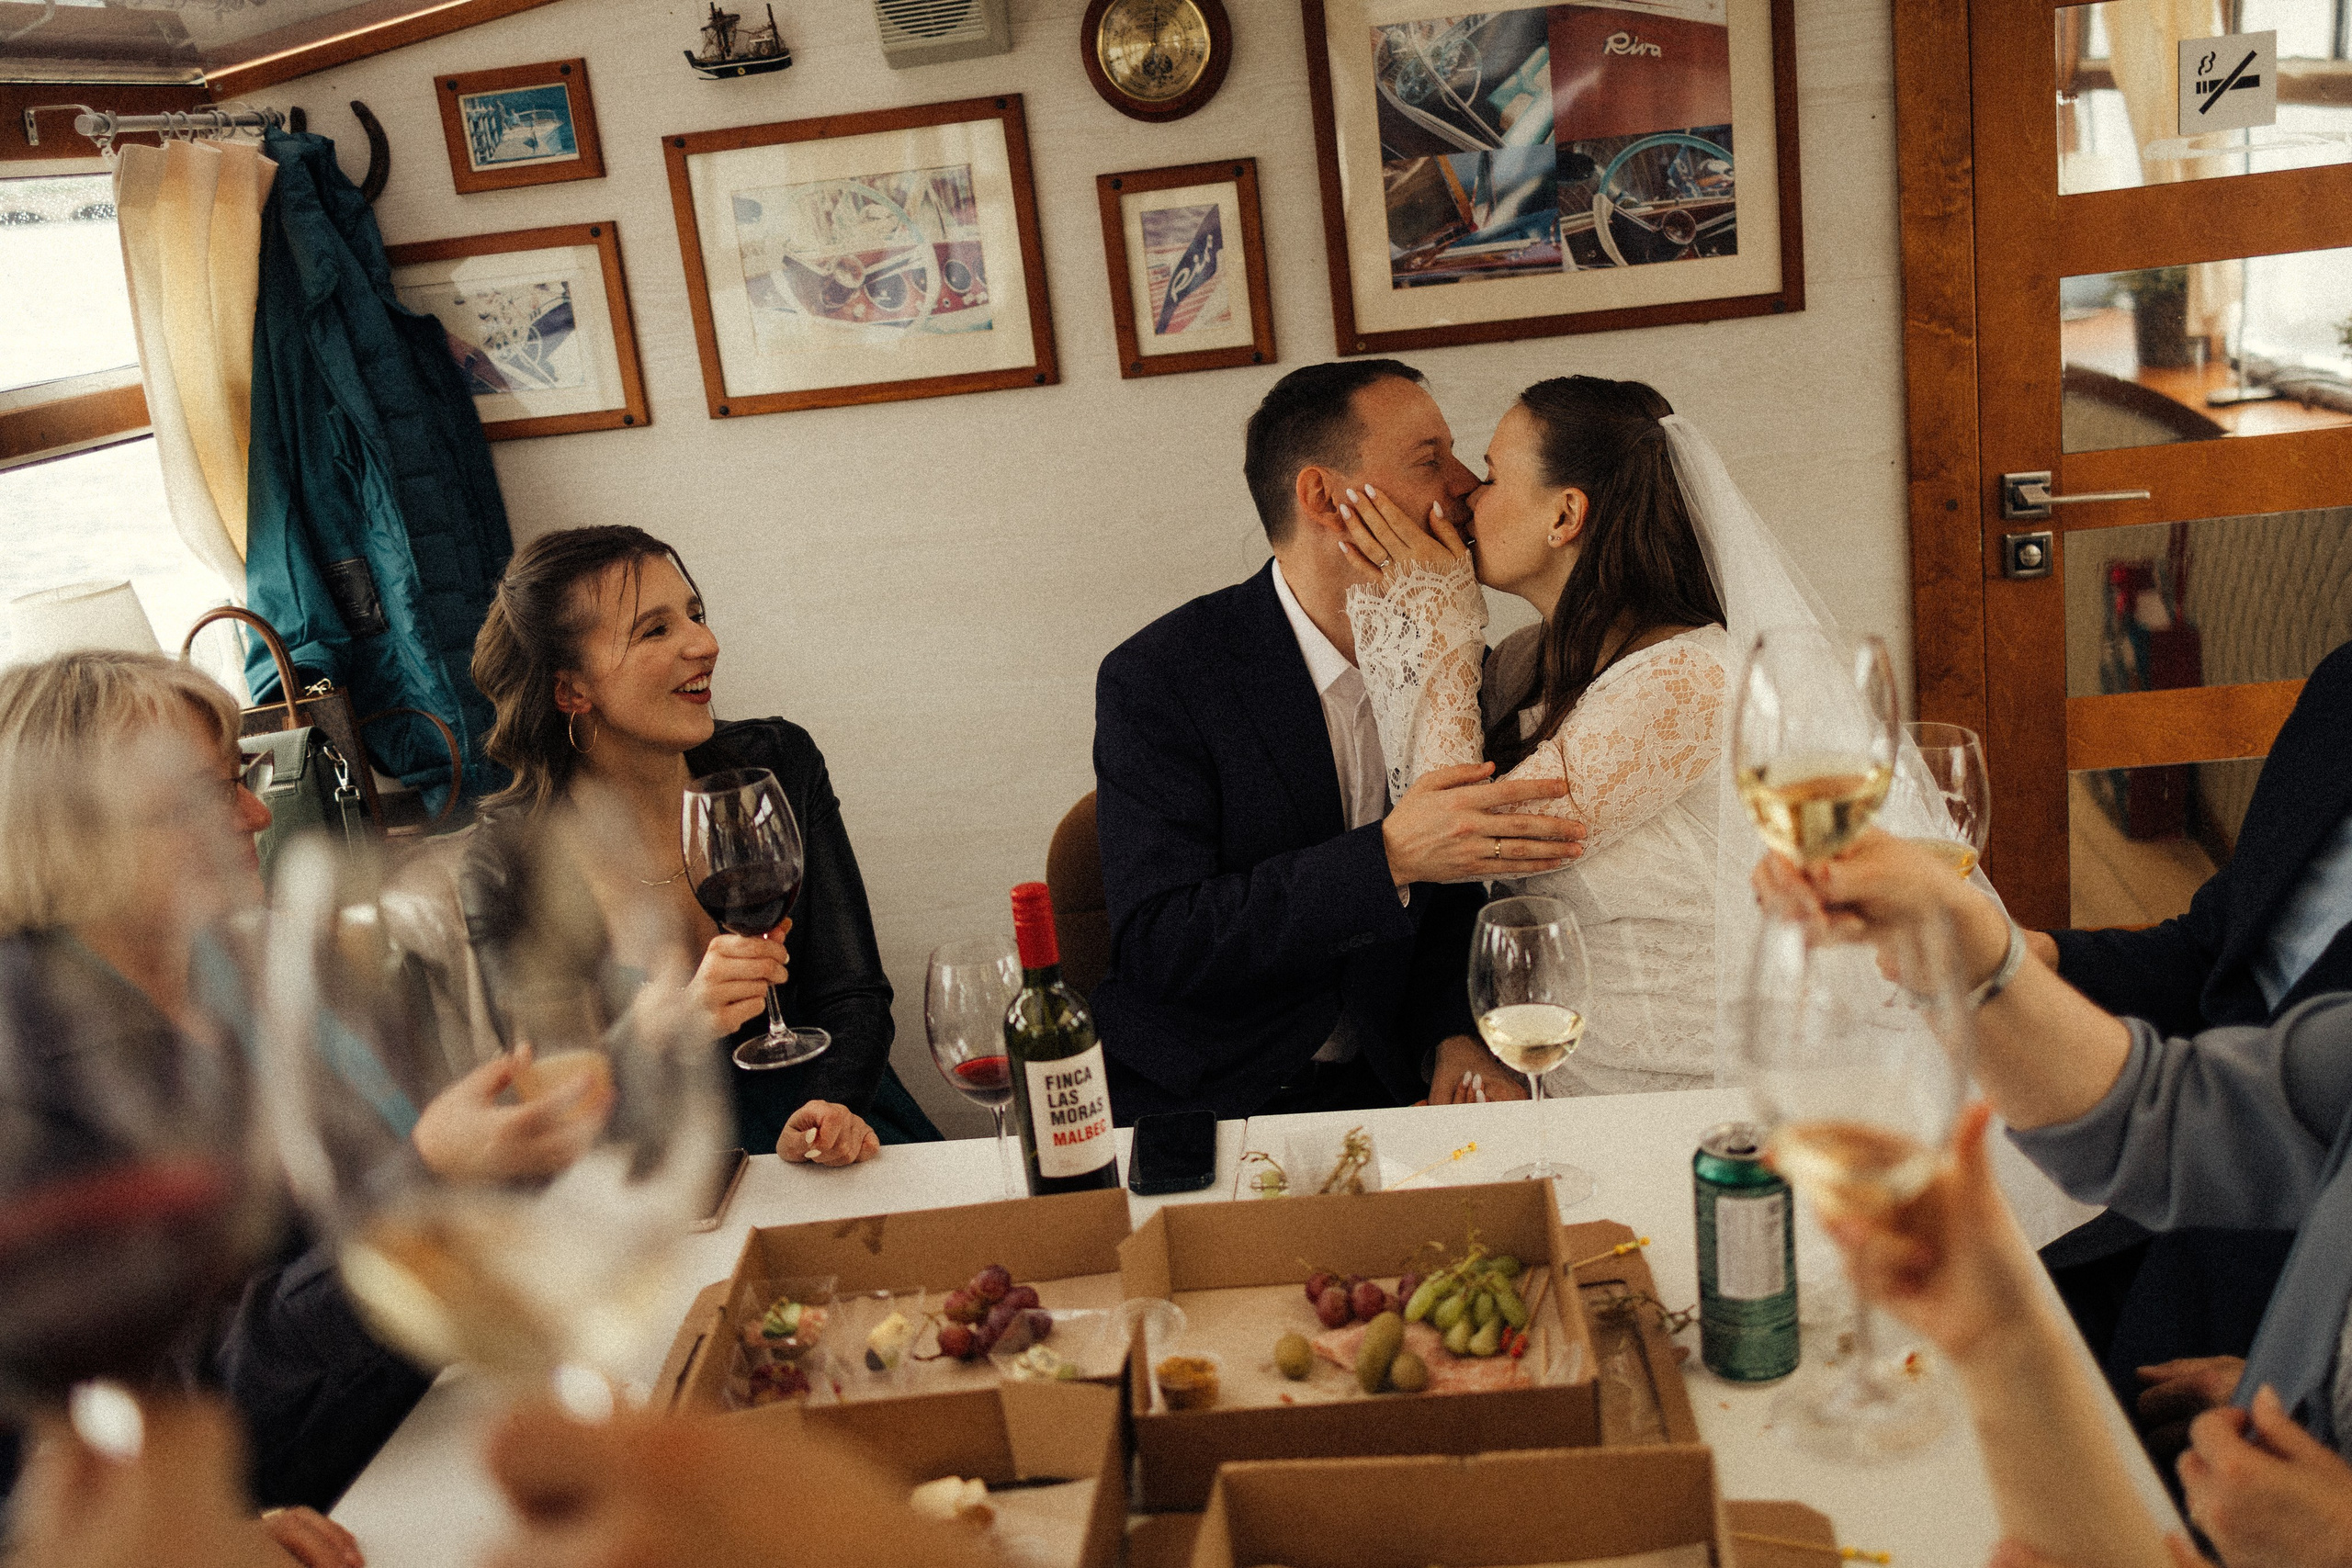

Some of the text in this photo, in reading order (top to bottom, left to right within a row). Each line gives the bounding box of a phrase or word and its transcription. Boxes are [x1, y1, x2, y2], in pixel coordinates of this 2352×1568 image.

[1603, 31, 1661, 57] Riva
[1046, 1066, 1092, 1090] FINCA
[1047, 1089, 1080, 1108] LAS
[1050, 1097, 1103, 1125] MORAS
[1053, 1118, 1106, 1146] MALBEC
